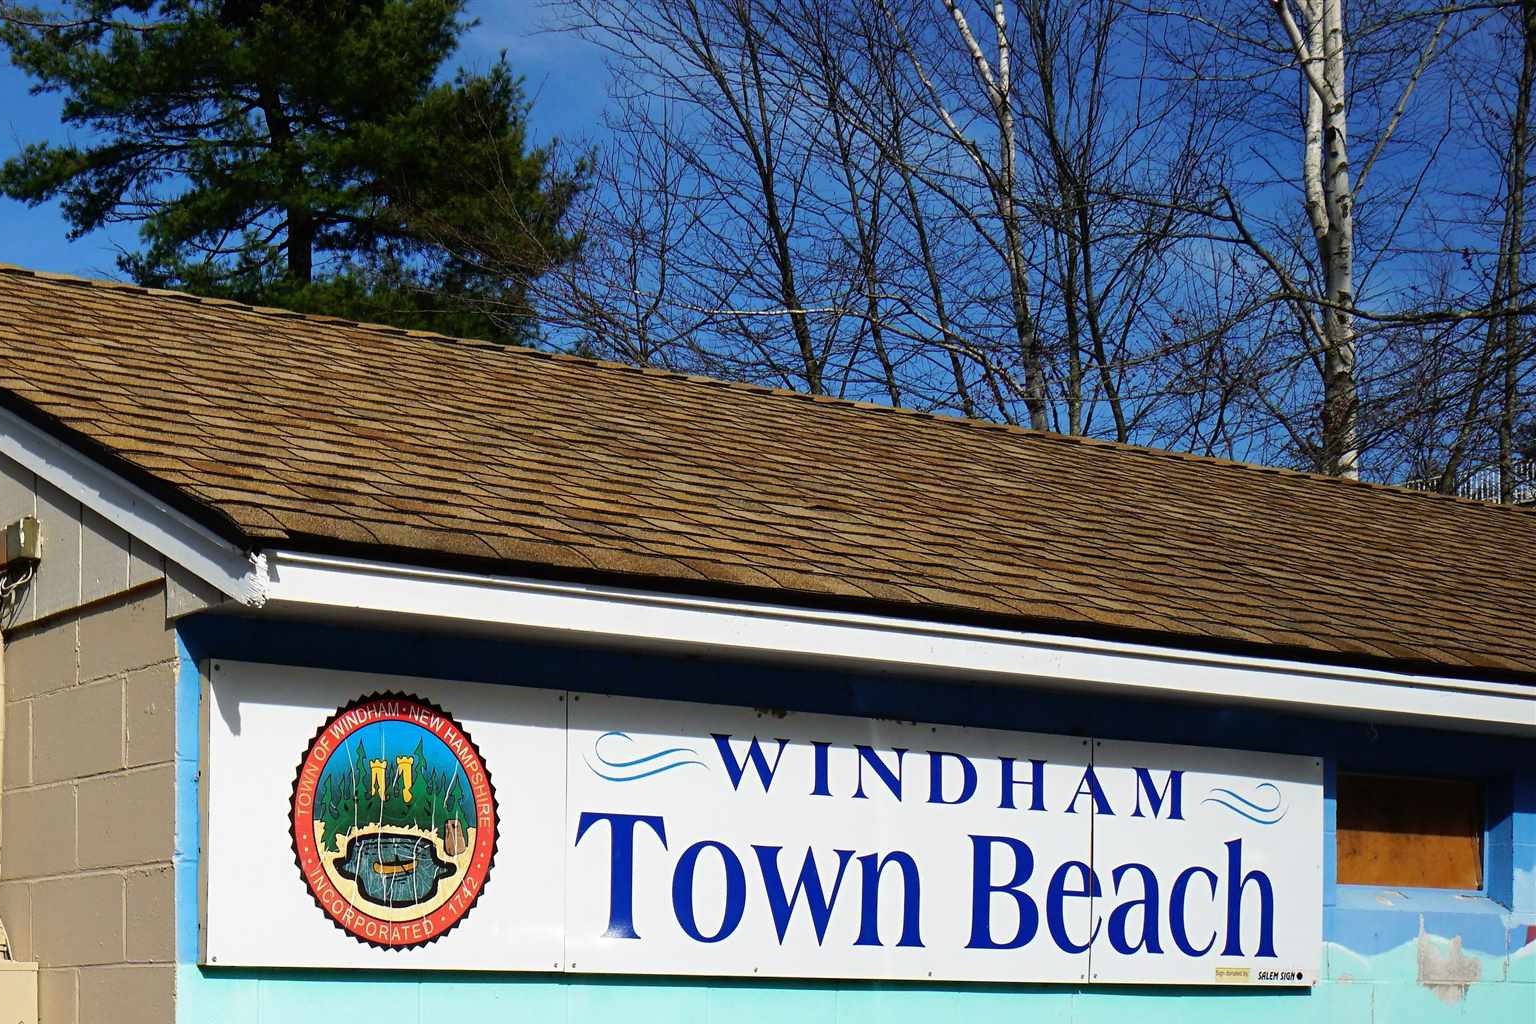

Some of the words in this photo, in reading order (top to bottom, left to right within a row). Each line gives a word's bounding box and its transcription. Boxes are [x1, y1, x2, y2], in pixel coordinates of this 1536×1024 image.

[297, 764, 320, 816] TOWN
[312, 738, 331, 762] OF
[329, 701, 400, 740] WINDHAM
[409, 706, 444, 732] NEW
[442, 727, 492, 828] HAMPSHIRE
[708, 732, 1186, 821] WINDHAM
[309, 866, 434, 942] INCORPORATED
[448, 878, 478, 915] 1742
[574, 811, 926, 950] Town
[965, 834, 1280, 959] Beach
[1258, 972, 1279, 980] SALEM
[1280, 972, 1296, 980] SIGN
